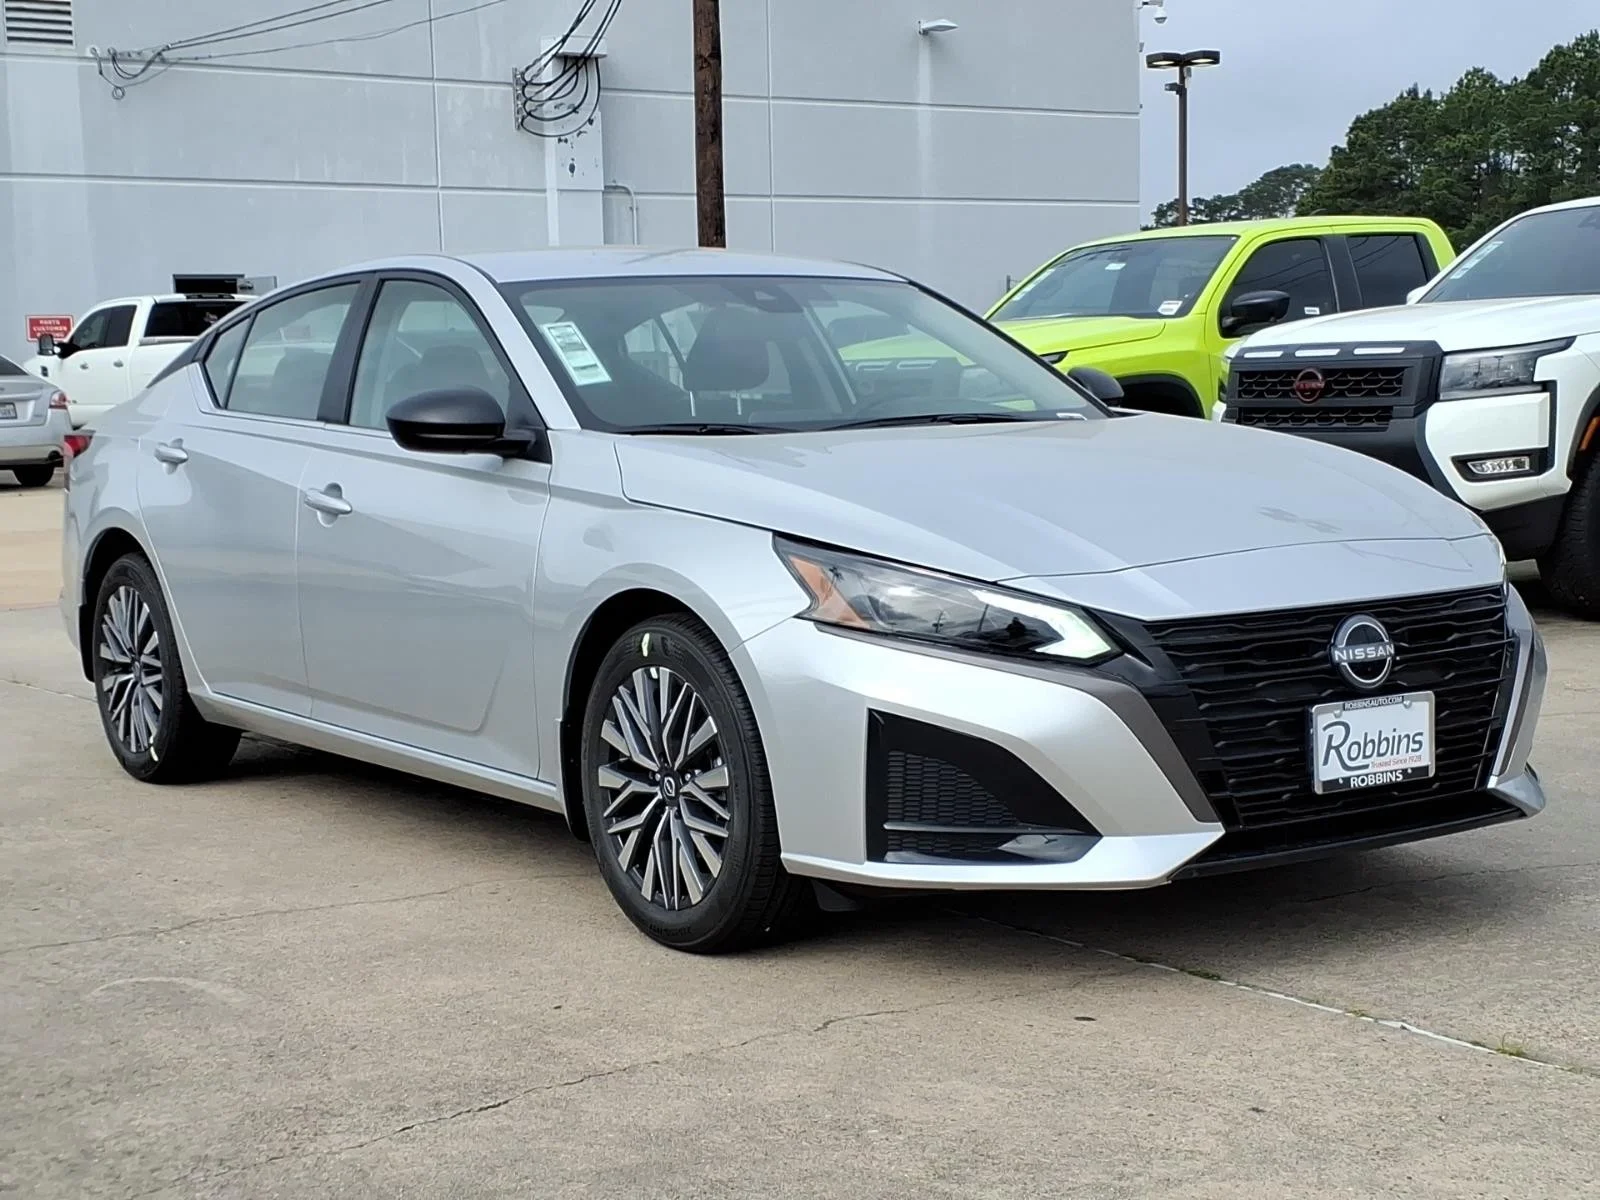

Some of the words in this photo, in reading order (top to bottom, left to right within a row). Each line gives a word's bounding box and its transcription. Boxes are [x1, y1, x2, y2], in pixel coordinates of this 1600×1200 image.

[1334, 643, 1395, 661] NISSAN
[1344, 696, 1404, 711] ROBBINSAUTO.COM
[1321, 720, 1424, 772] Robbins
[1392, 756, 1408, 767] Since
[1350, 770, 1404, 788] ROBBINS
